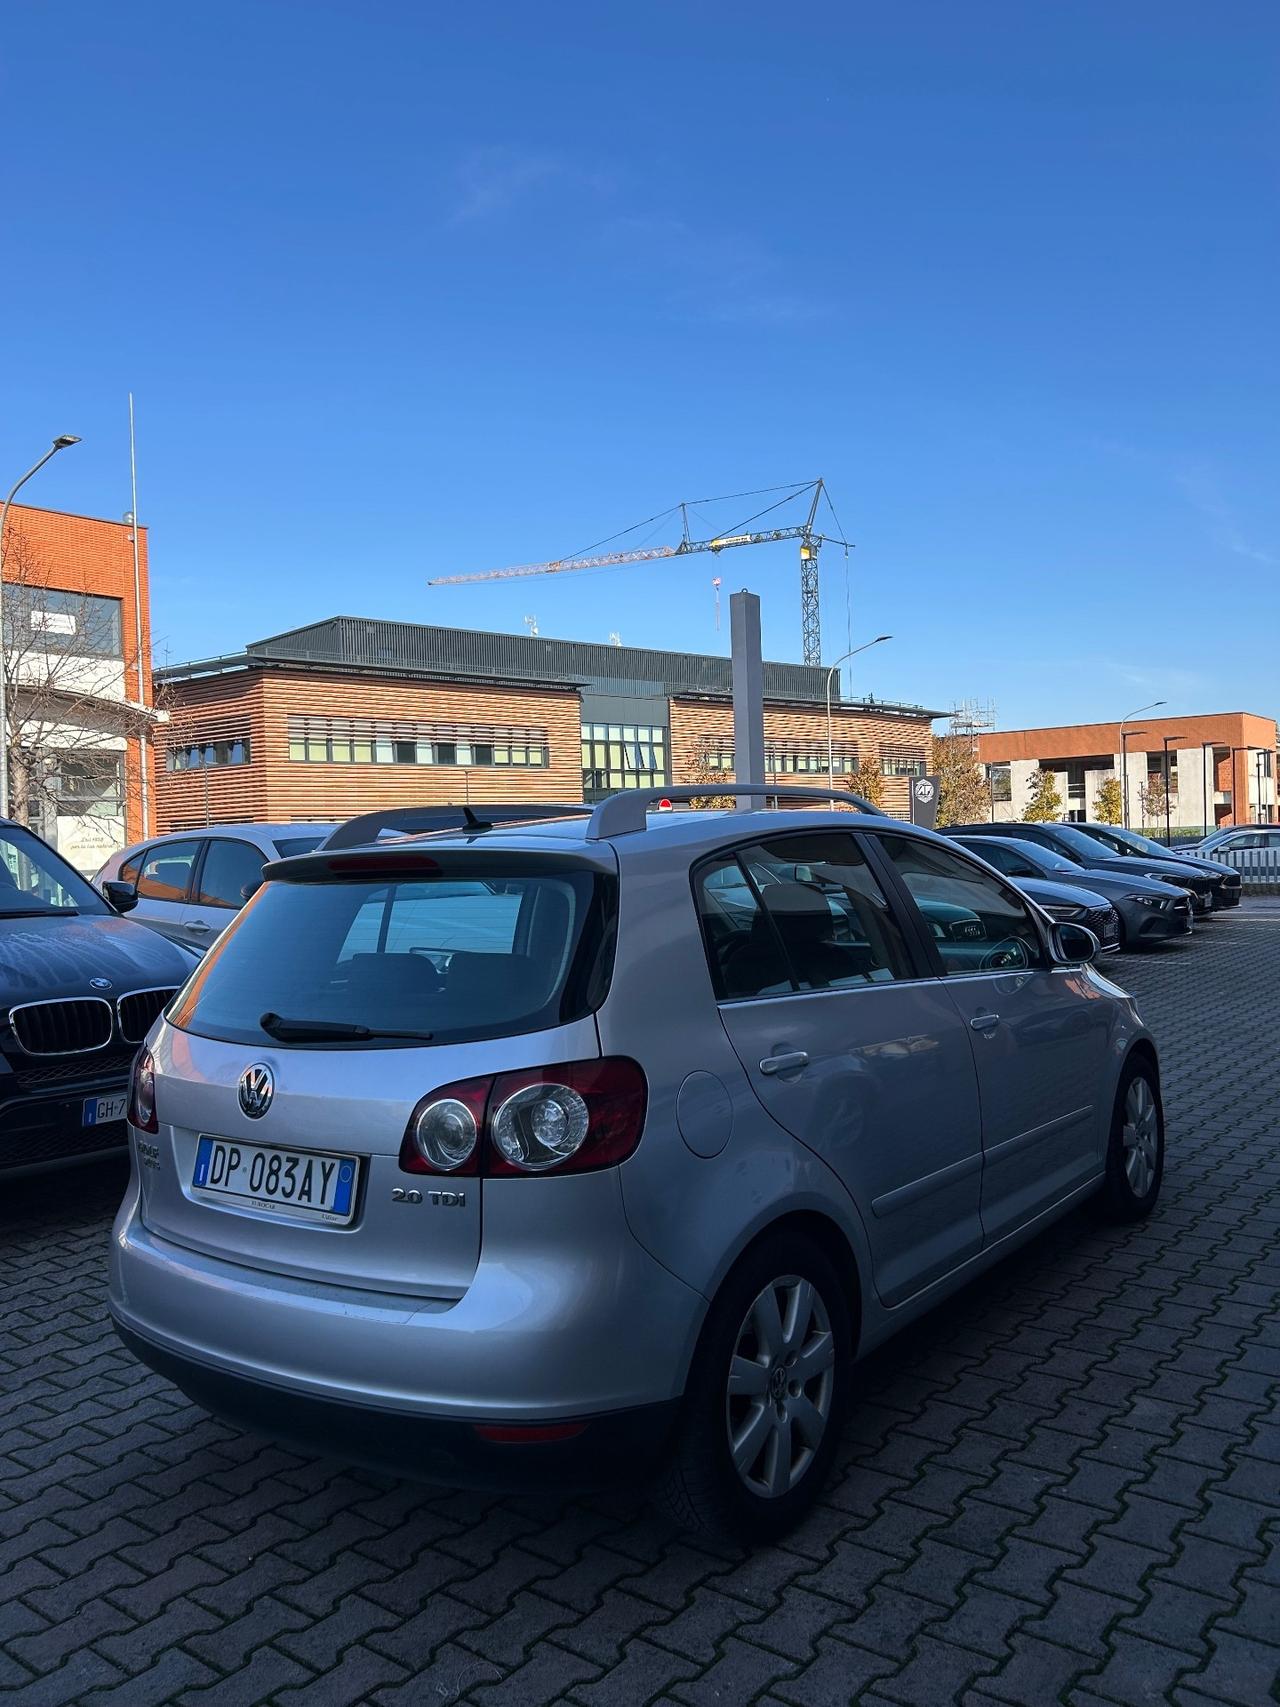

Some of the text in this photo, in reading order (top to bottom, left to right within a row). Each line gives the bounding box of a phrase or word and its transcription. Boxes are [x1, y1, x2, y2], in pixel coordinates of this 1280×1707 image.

[97, 1101, 114, 1119] GH
[210, 1144, 336, 1205] DP 083AY
[427, 1190, 466, 1208] TDI
